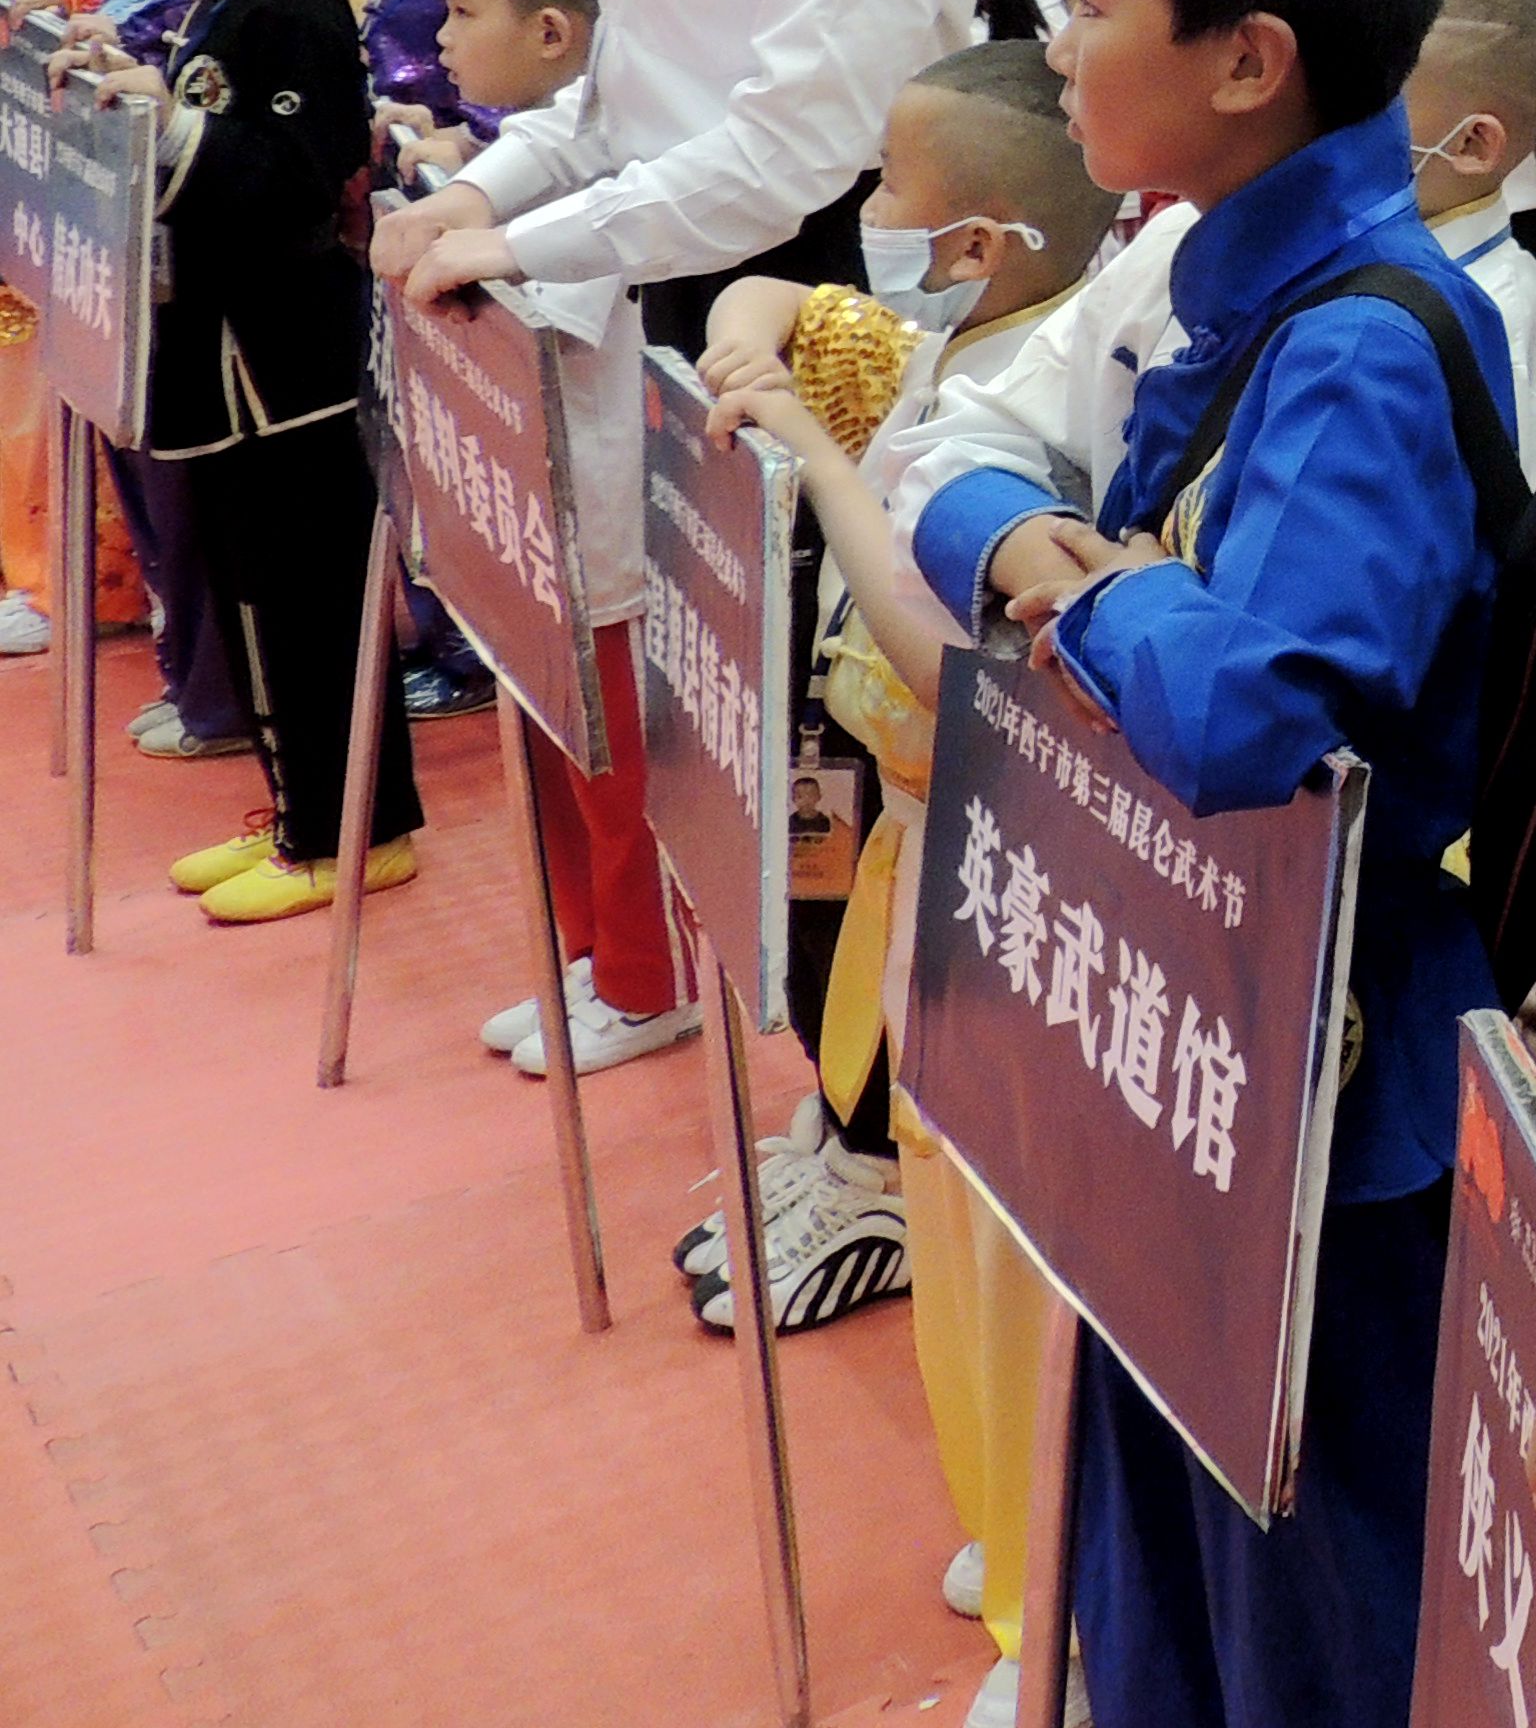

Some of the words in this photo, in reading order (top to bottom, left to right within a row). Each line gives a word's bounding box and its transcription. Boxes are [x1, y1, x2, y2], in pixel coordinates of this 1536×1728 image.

[973, 668, 1246, 930] 2021年西宁市第三届昆仑武术节
[953, 794, 1248, 1193] 英豪武道馆
